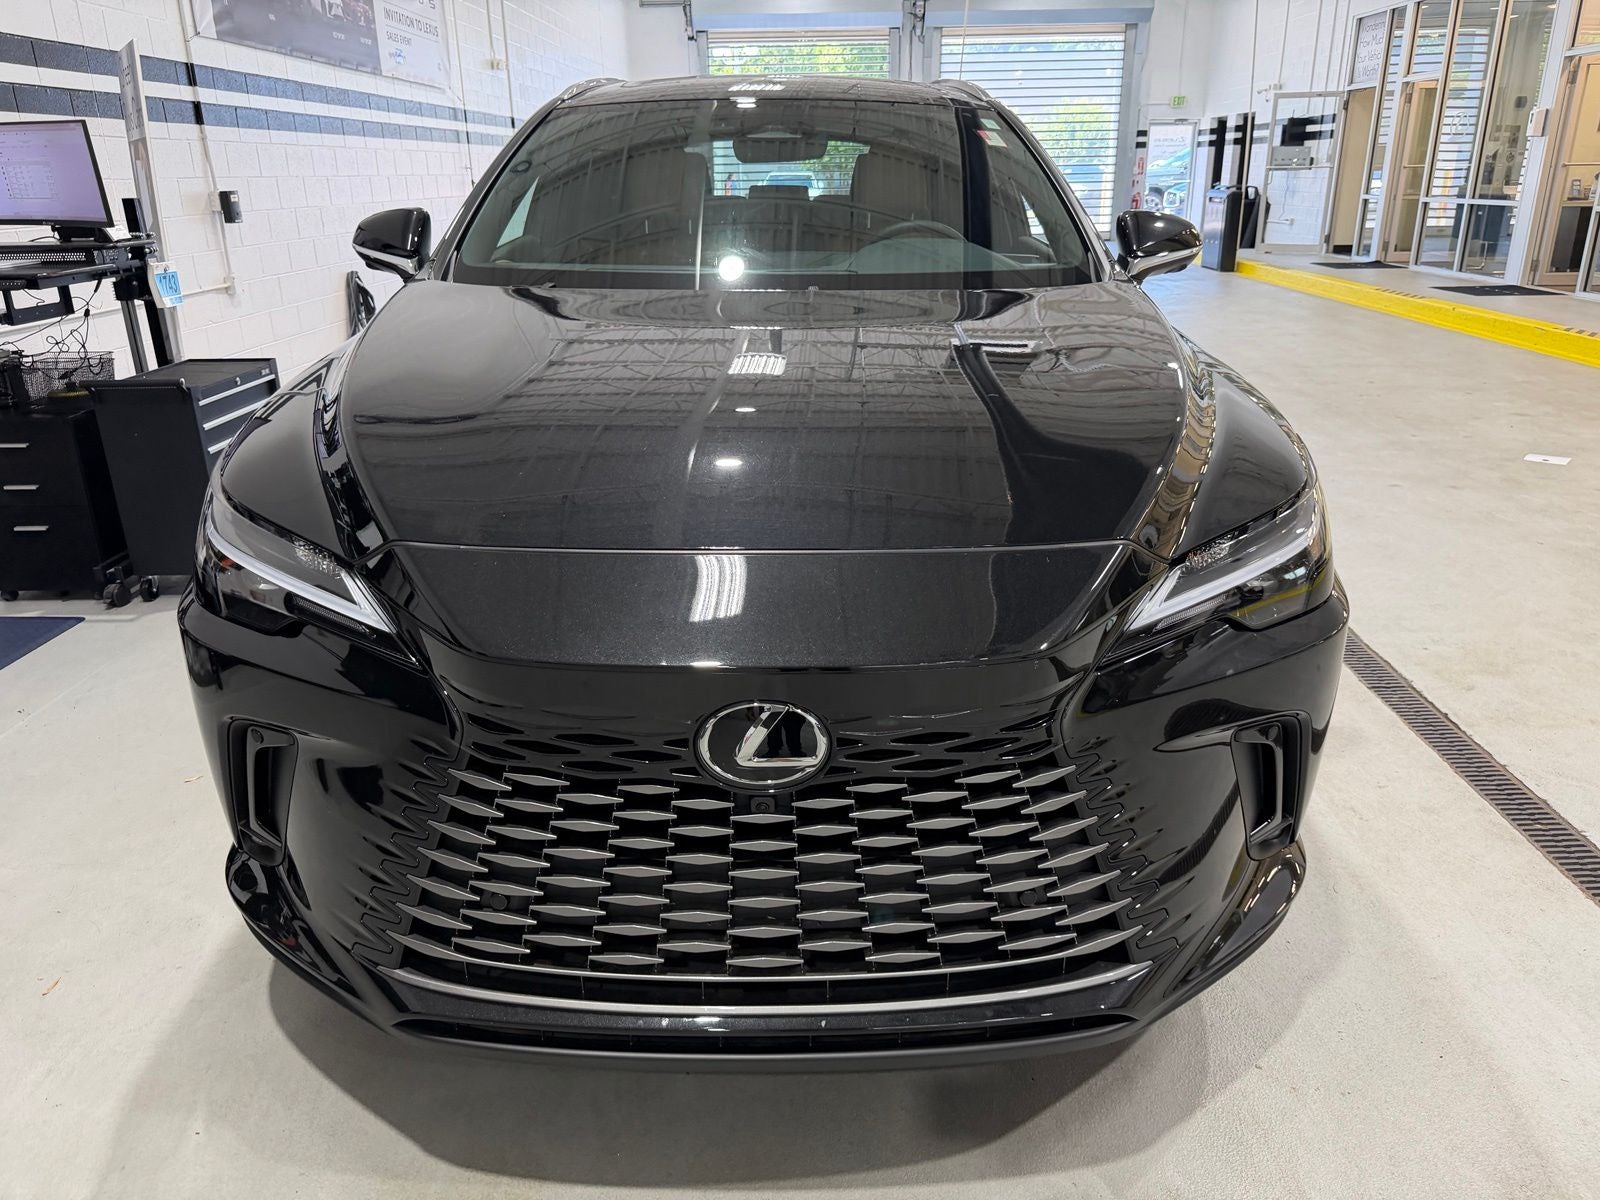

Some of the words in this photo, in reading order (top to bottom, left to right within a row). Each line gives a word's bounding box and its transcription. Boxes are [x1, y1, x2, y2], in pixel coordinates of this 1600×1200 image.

[383, 6, 415, 29] INVITATION
[415, 18, 423, 32] TO
[423, 21, 439, 38] LEXUS
[1370, 33, 1384, 46] Muc
[1172, 96, 1186, 106] EXIT
